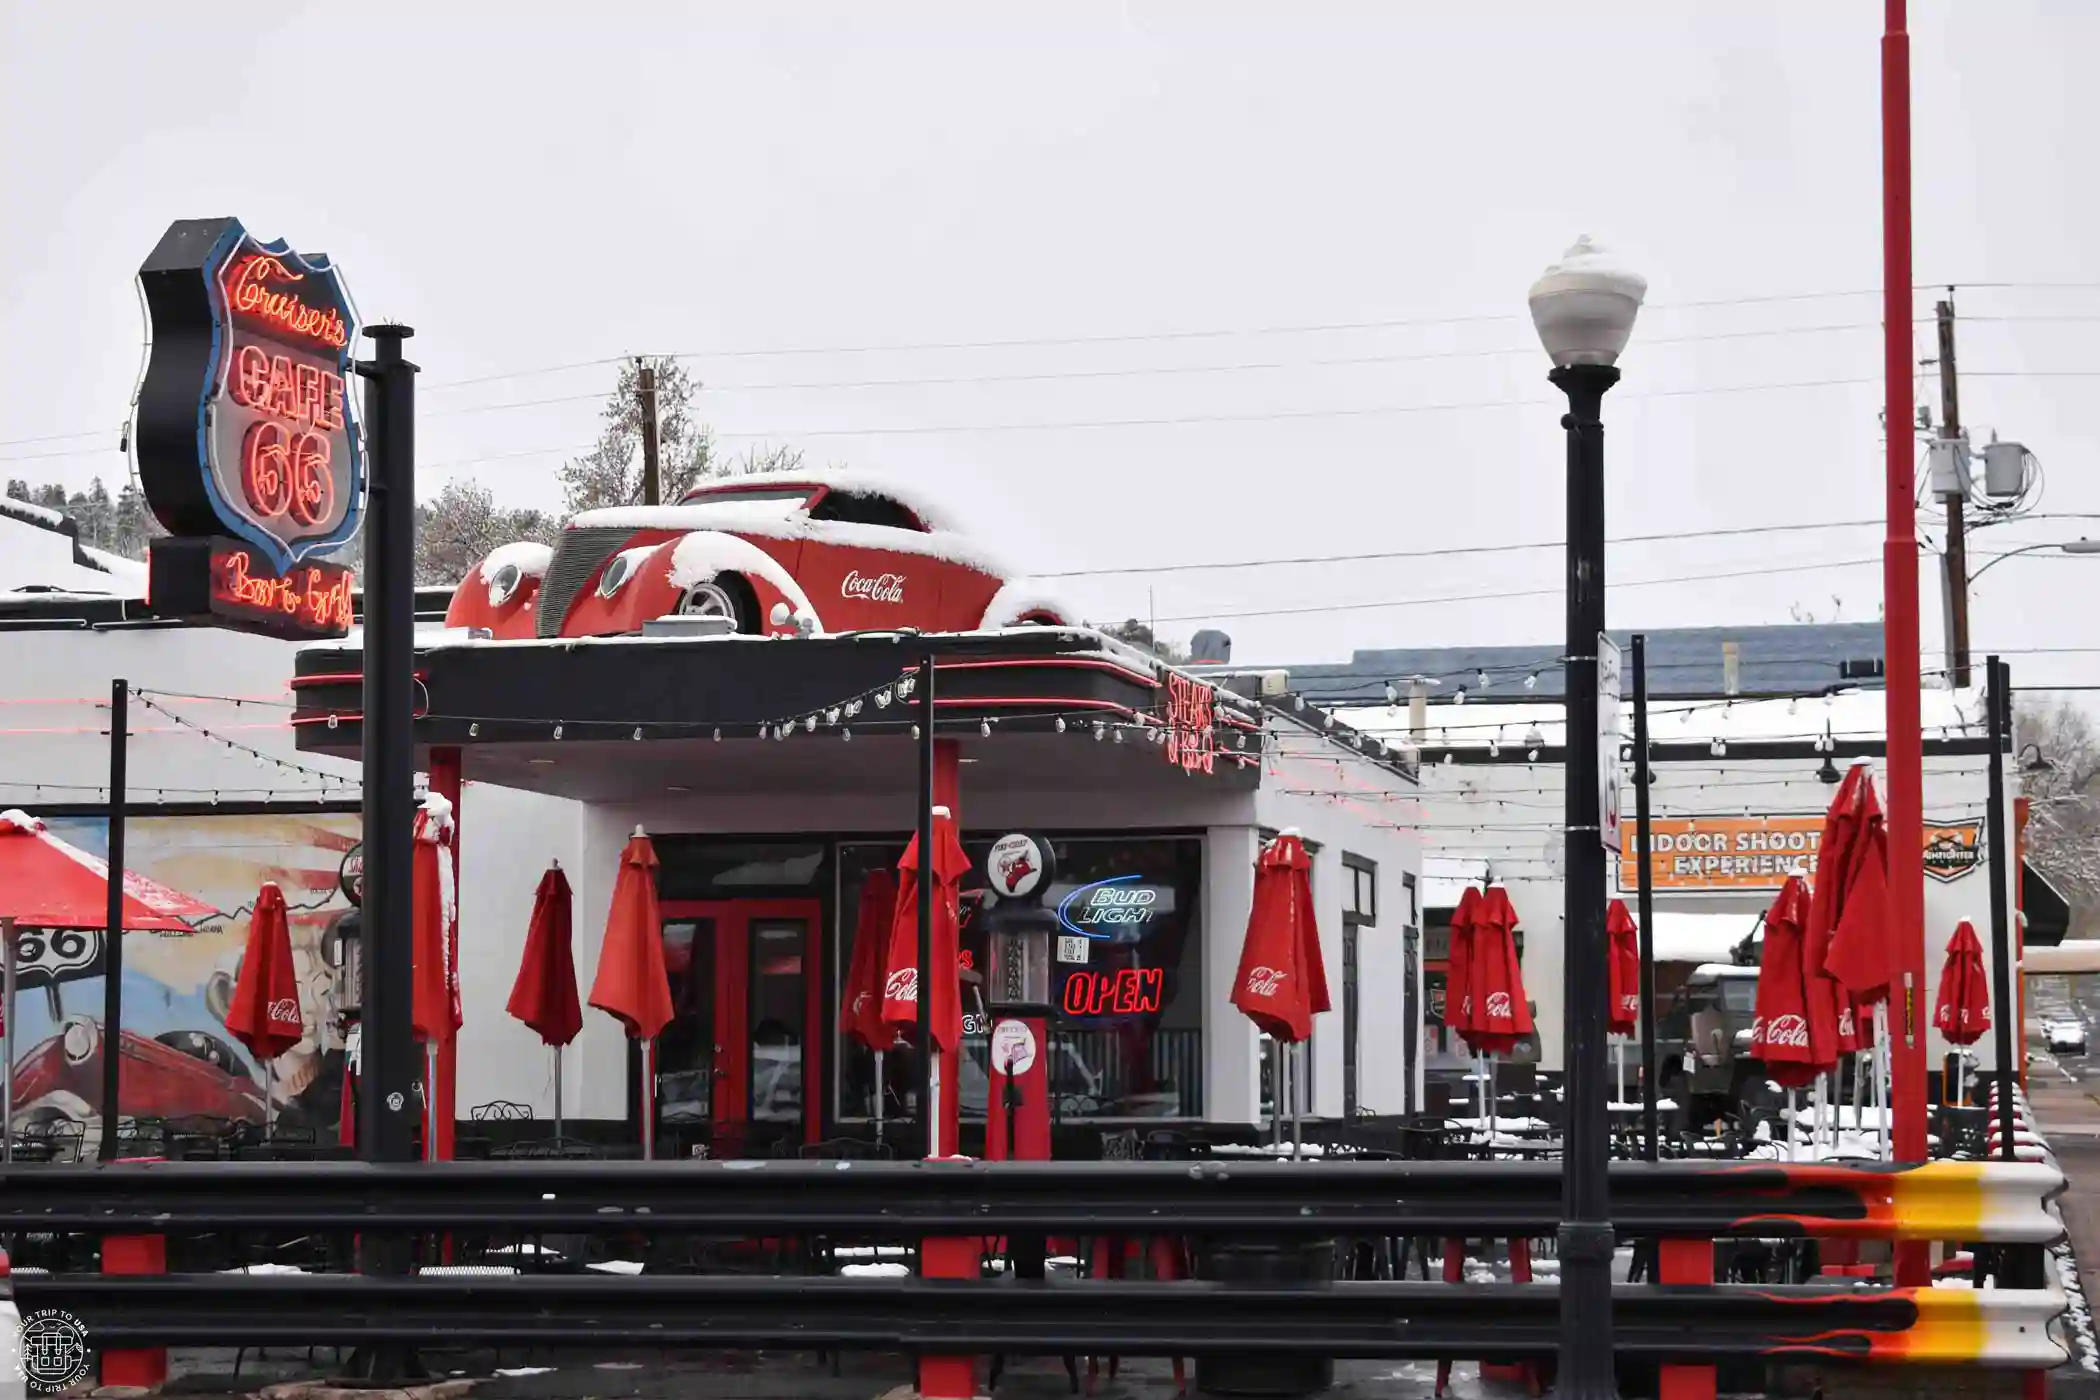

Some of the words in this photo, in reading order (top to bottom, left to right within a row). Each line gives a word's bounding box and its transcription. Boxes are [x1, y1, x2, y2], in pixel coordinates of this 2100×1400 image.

[236, 256, 348, 347] Cruiser's
[240, 345, 345, 431] CAFE
[252, 422, 334, 524] 66
[226, 552, 276, 607] Bar
[1630, 832, 1728, 852] IDOOR
[1063, 968, 1163, 1015] OPEN
